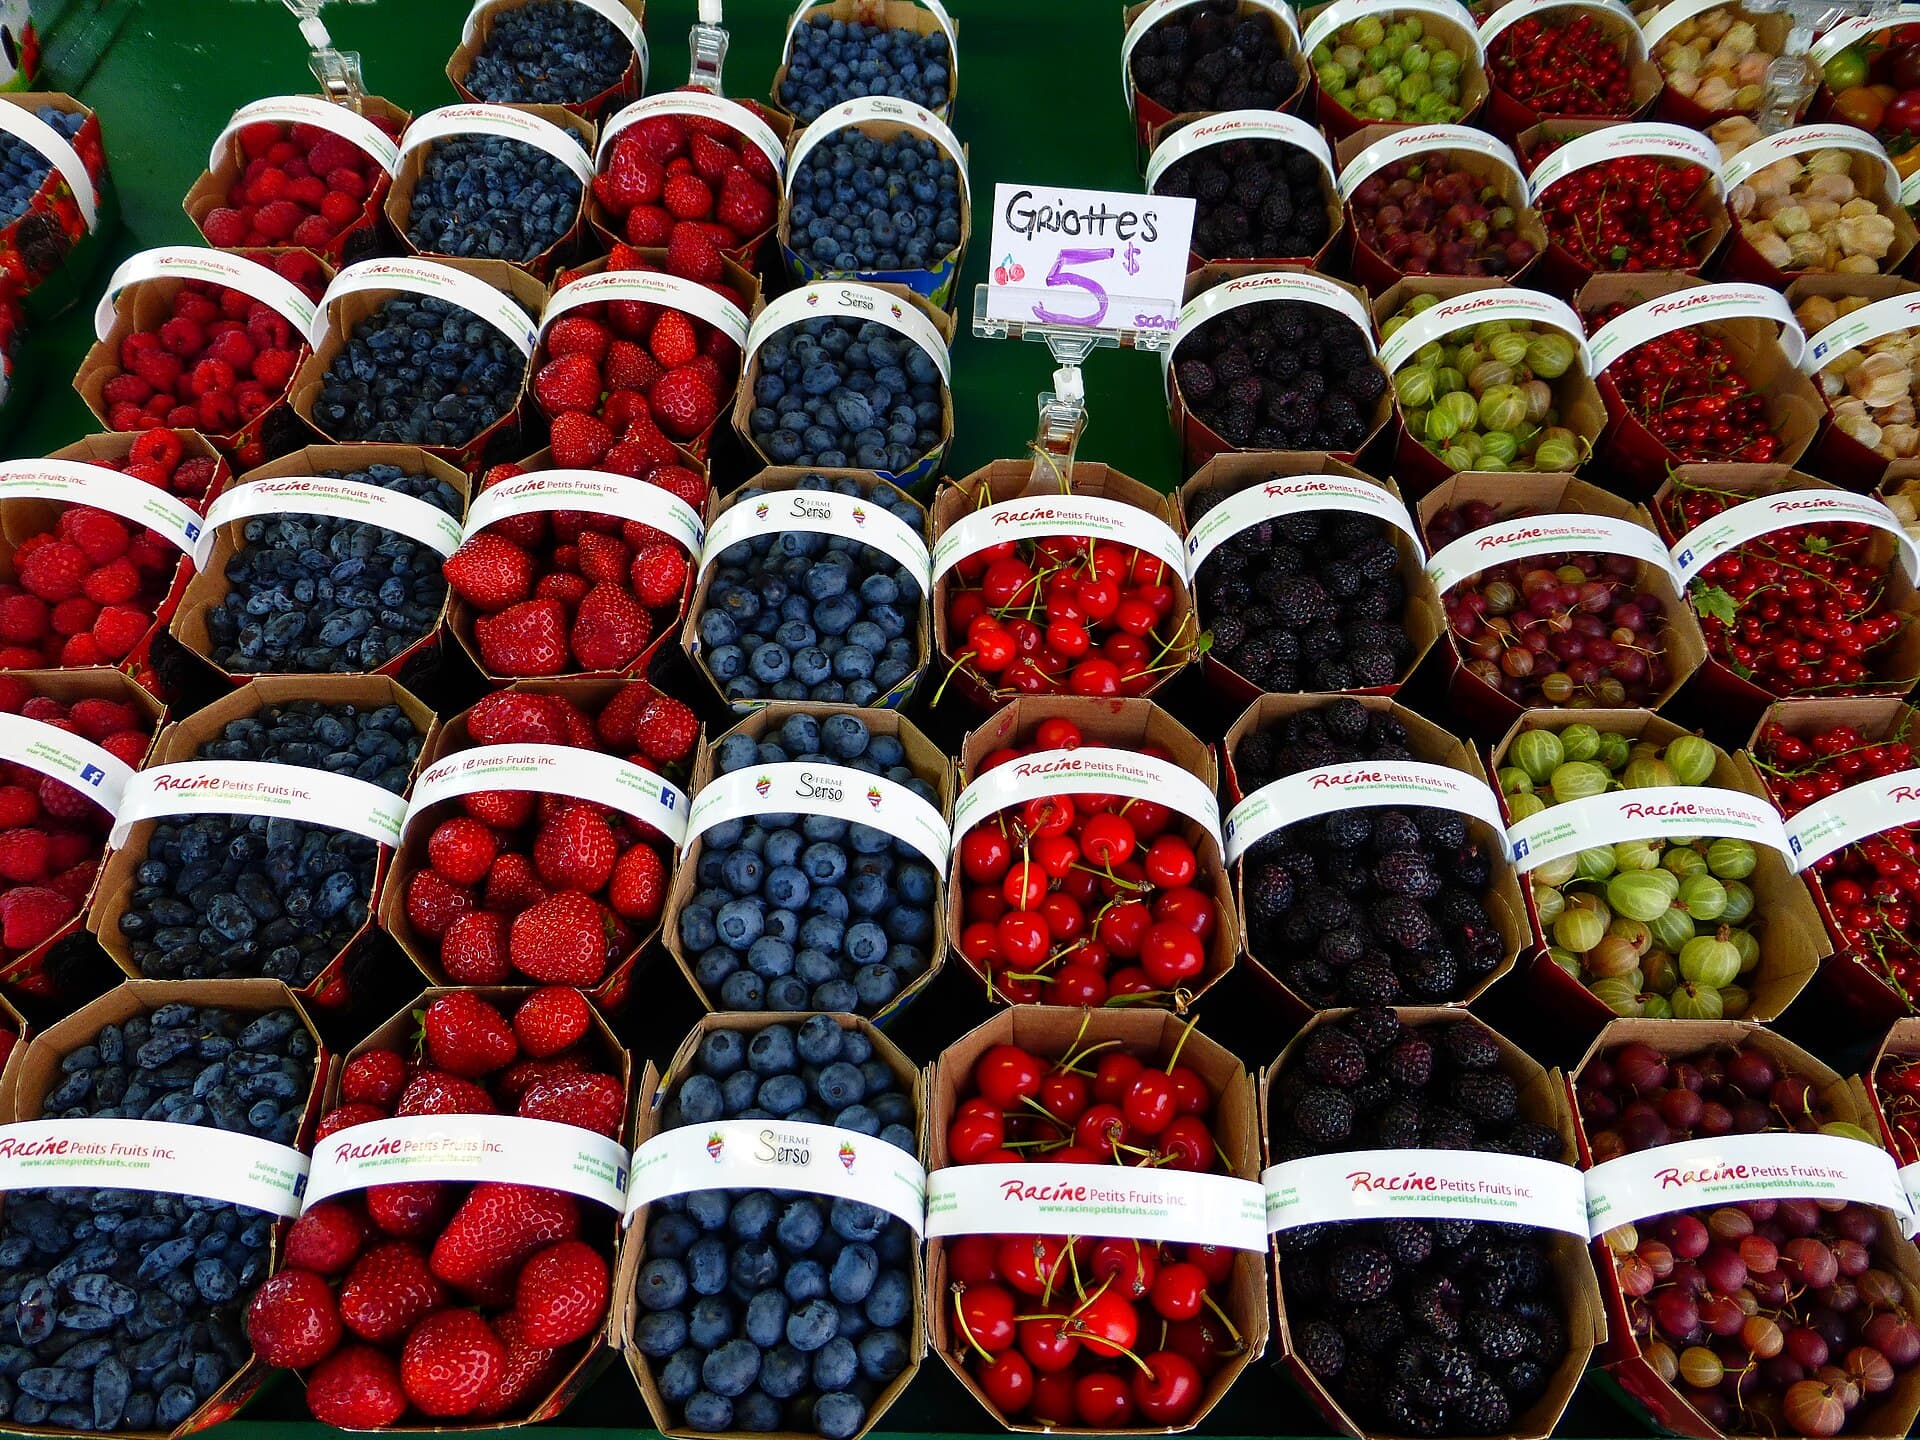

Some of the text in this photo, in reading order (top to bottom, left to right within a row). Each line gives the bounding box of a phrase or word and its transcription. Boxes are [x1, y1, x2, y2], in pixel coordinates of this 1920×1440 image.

[1032, 248, 1115, 327] 5
[1225, 277, 1282, 293] Racine
[838, 290, 874, 311] Serso
[1436, 297, 1496, 319] Racine
[1648, 294, 1710, 316] Racine
[252, 481, 311, 494] Racine
[789, 497, 832, 520] Serso
[1769, 498, 1838, 513] Racine
[991, 508, 1055, 526] Racine
[1475, 527, 1542, 551] Racine
[476, 754, 557, 767] Petits Fruits inc.
[1014, 758, 1083, 780] Racine
[1084, 760, 1114, 771] Petits
[1116, 762, 1145, 777] Fruits
[153, 774, 312, 800] Racine Petits Fruits inc.
[796, 772, 844, 802] Serso
[1307, 770, 1383, 790] Racine
[1383, 773, 1414, 784] Petits
[1620, 801, 1698, 819] Racine
[0, 1136, 176, 1162] Racine Petits Fruits inc.
[336, 1136, 402, 1165] Racine
[482, 1141, 504, 1154] inc.
[754, 1129, 811, 1166] Serso
[777, 1133, 811, 1146] FERME
[1345, 1172, 1533, 1199] Racine Petits Fruits inc.
[1654, 1162, 1848, 1190] Racine Petits Fruits inc.
[1000, 1179, 1088, 1204] Racine
[1090, 1187, 1126, 1204] Petits
[1129, 1189, 1165, 1205] Fruits
[1038, 1203, 1169, 1219] www.racinepetitsfruits.com
